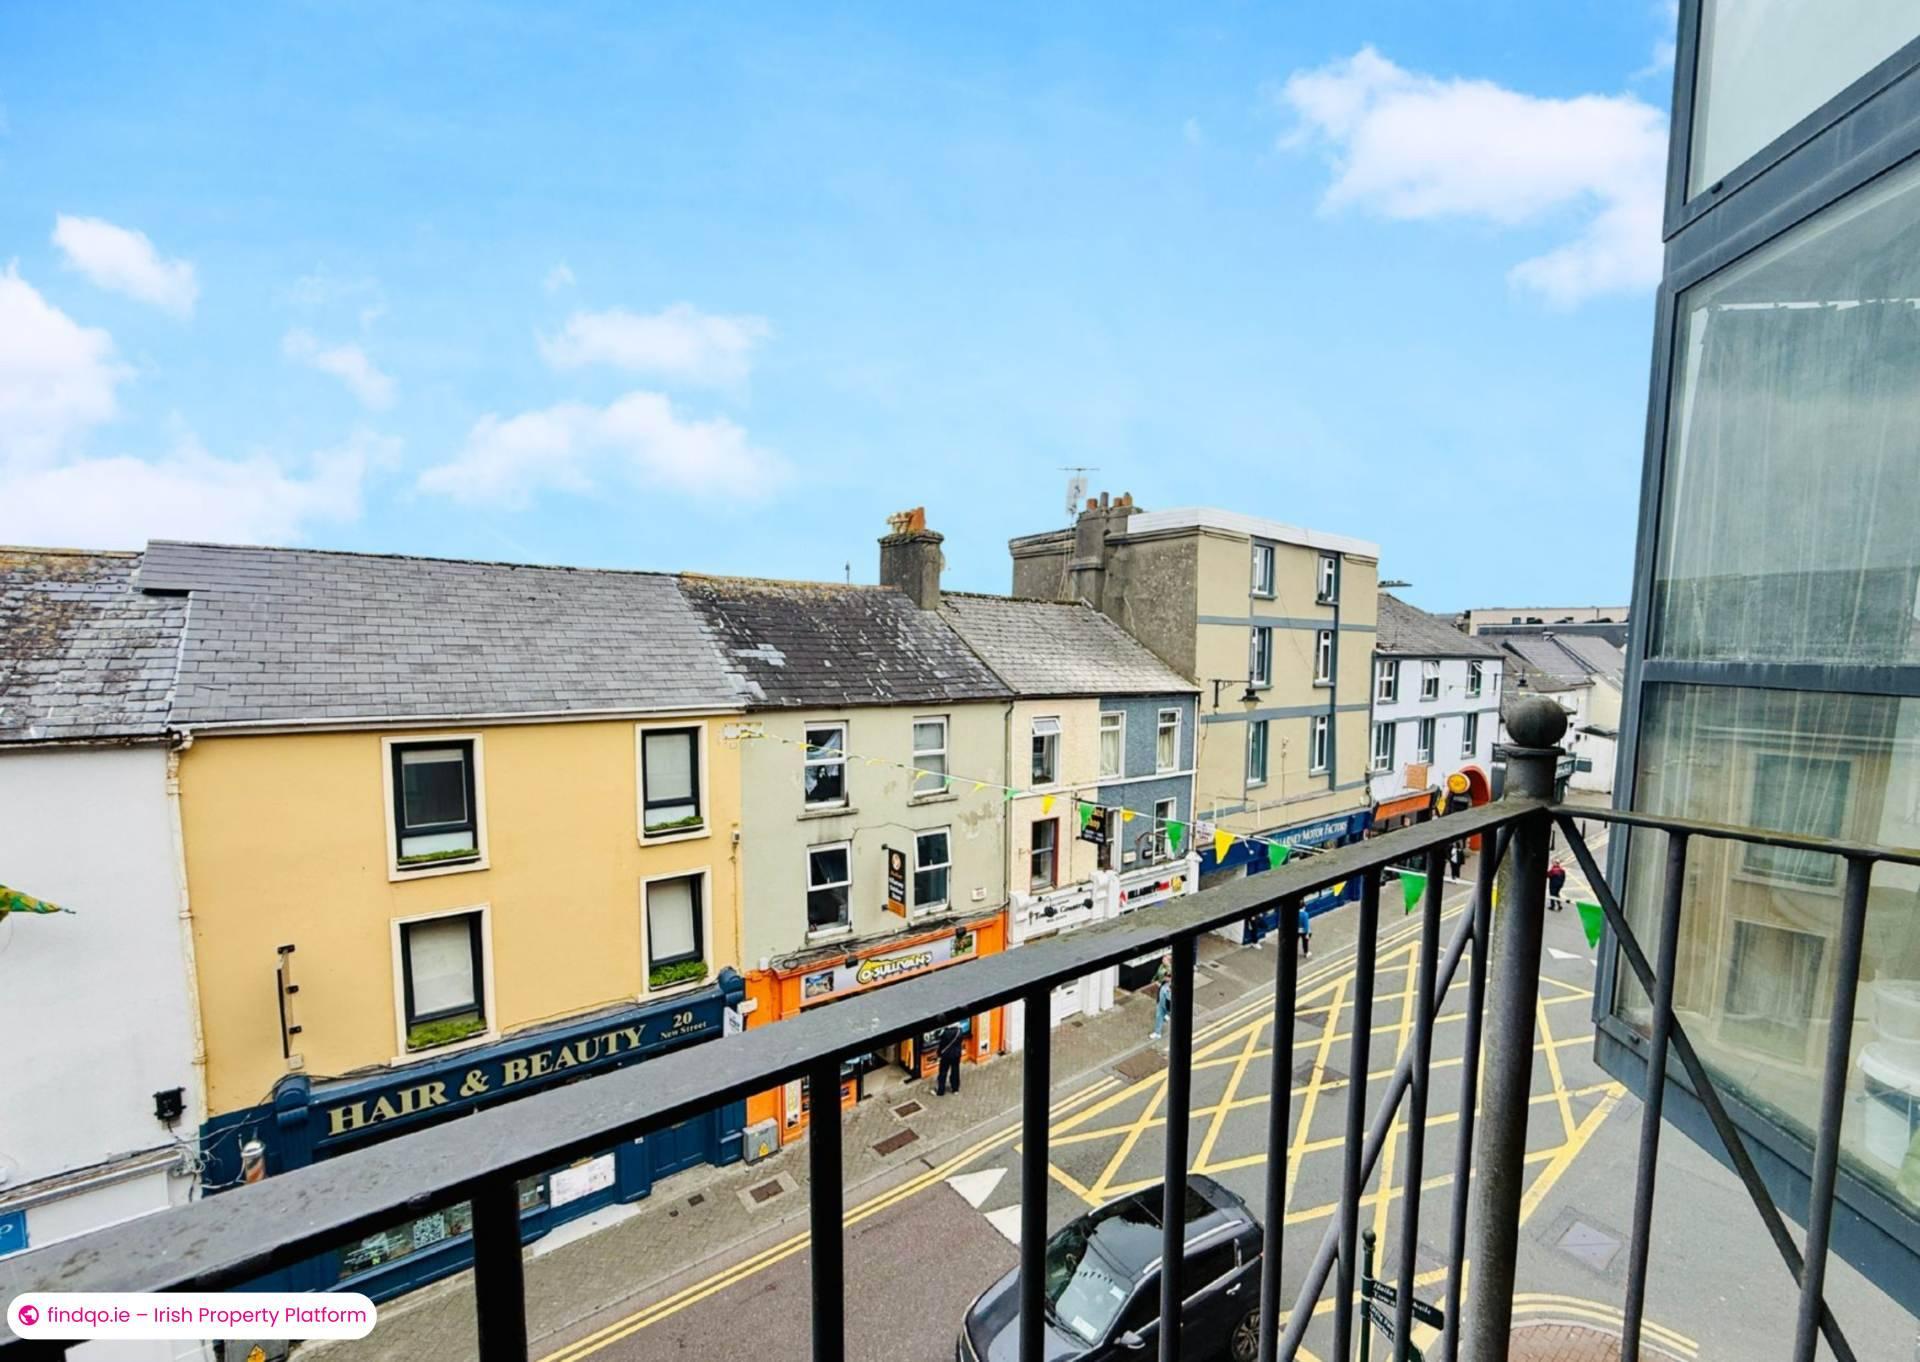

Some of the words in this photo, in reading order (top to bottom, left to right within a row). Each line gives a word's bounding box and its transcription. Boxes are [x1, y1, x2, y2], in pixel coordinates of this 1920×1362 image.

[673, 1011, 693, 1028] 20
[661, 1030, 678, 1040] New
[681, 1021, 707, 1033] Street
[328, 1081, 449, 1136] HAIR
[459, 1068, 490, 1097] &
[502, 1025, 647, 1087] BEAUTY
